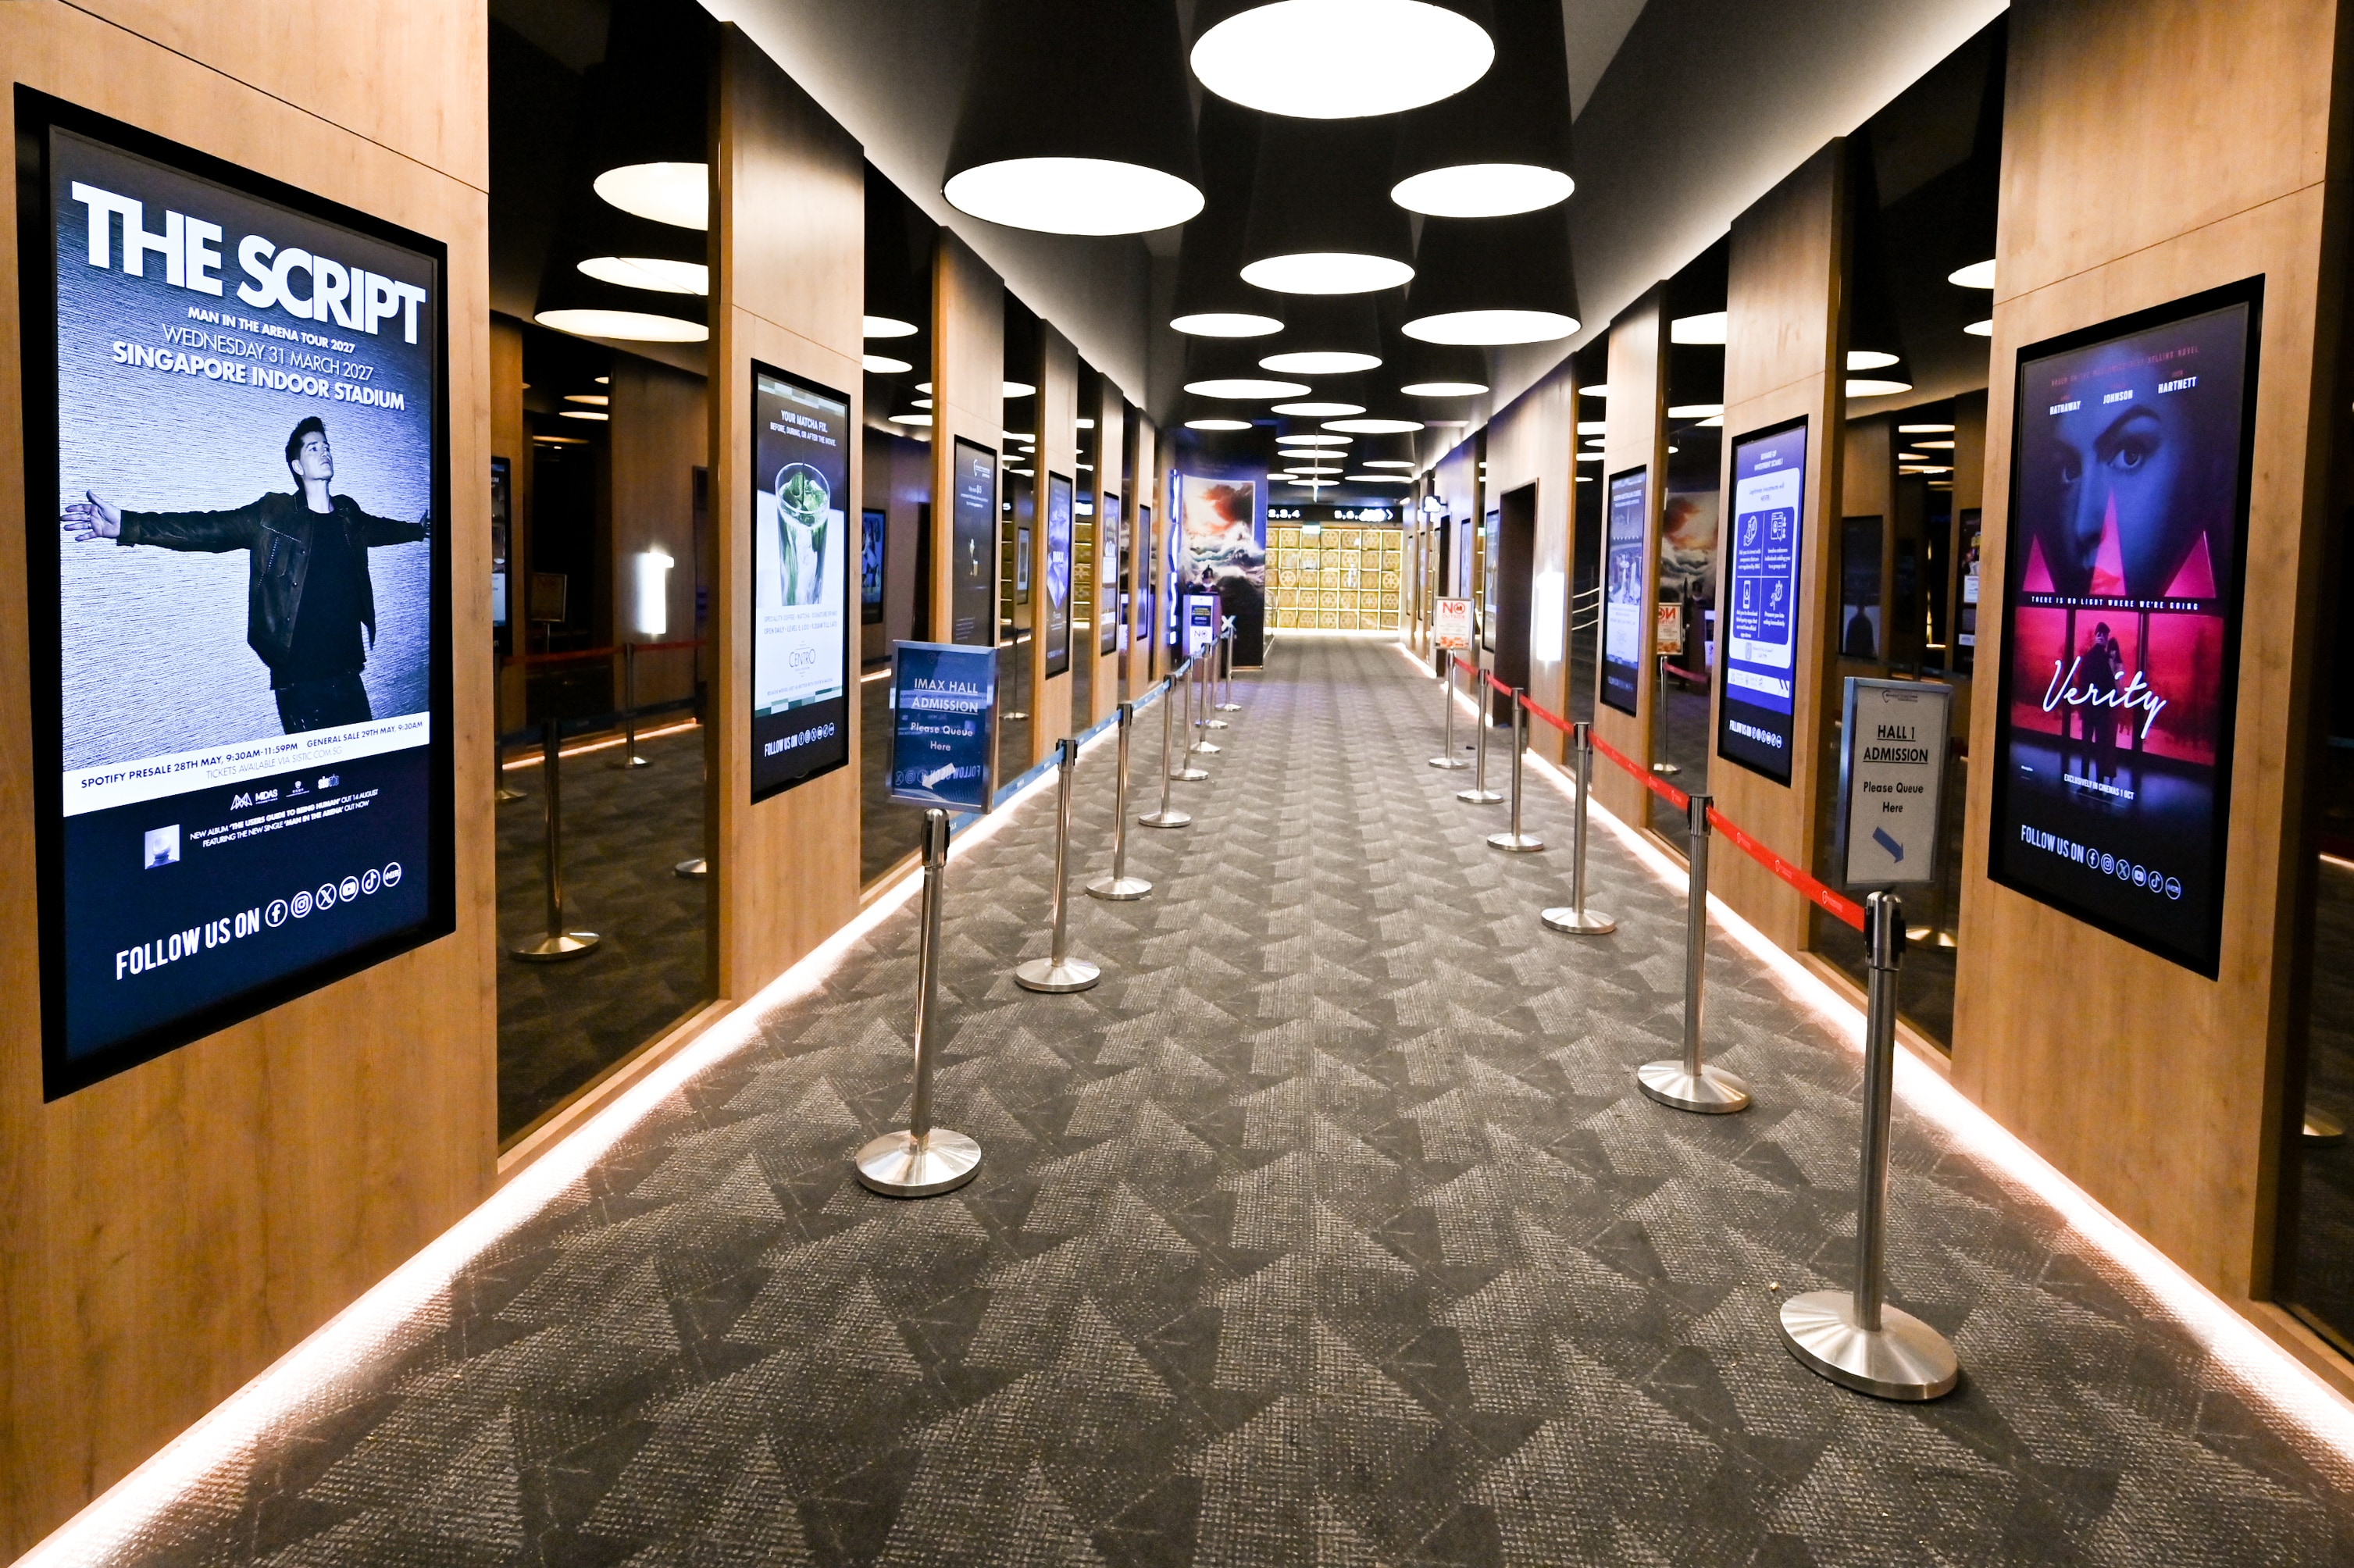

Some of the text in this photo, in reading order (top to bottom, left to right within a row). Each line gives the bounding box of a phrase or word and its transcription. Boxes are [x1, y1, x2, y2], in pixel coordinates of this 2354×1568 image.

[72, 180, 426, 344] THE SCRIPT
[187, 307, 355, 354] MAN IN THE ARENA TOUR 2027
[162, 323, 374, 381] WEDNESDAY 31 MARCH 2027
[112, 340, 405, 411] SINGAPORE INDOOR STADIUM
[2049, 376, 2197, 415] HATHAWAY JOHNSON HARTNETT
[781, 410, 796, 424] YOUR
[797, 415, 819, 430] MATCHA
[2108, 599, 2135, 608] WHERE
[2139, 600, 2164, 609] WE'RE
[2170, 602, 2199, 611] GOING
[789, 648, 816, 668] CENTRO
[915, 678, 978, 693] IMAX HALL
[2042, 656, 2167, 739] Verity
[912, 697, 978, 712] ADMISSION
[306, 721, 423, 748] GENERAL SALE 29TH MAY, 9:30AM
[911, 722, 973, 737] Please Queue
[1878, 725, 1915, 739] HALL 1
[765, 734, 797, 757] FOLLOW US ON
[930, 741, 951, 751] Here
[1864, 747, 1928, 762] ADMISSION
[81, 772, 127, 789] SPOTIFY
[129, 764, 172, 779] PRESALE
[173, 759, 198, 772] 28TH
[200, 755, 224, 767] MAY,
[206, 766, 236, 779] TICKETS
[238, 758, 276, 772] AVAILABLE
[277, 754, 291, 765] VIA
[255, 789, 278, 802] MIDAS
[1864, 782, 1924, 793] Please Queue
[2063, 773, 2092, 789] EXCLUSIVELY
[2092, 781, 2098, 790] IN
[2099, 782, 2120, 796] CINEMAS
[2124, 790, 2135, 800] OCT
[190, 830, 207, 840] NEW
[207, 825, 228, 837] ALBUM
[245, 815, 266, 827] USERS
[341, 795, 352, 804] OUT
[359, 789, 379, 800] AUGUST
[1882, 802, 1903, 813] Here
[202, 833, 236, 847] FEATURING
[237, 830, 248, 839] THE
[248, 827, 263, 837] NEW
[263, 821, 284, 832] SINGLE
[344, 803, 355, 811] OUT
[355, 800, 369, 809] NOW
[2021, 824, 2085, 864] FOLLOW US ON
[115, 907, 259, 981] FOLLOW US ON
